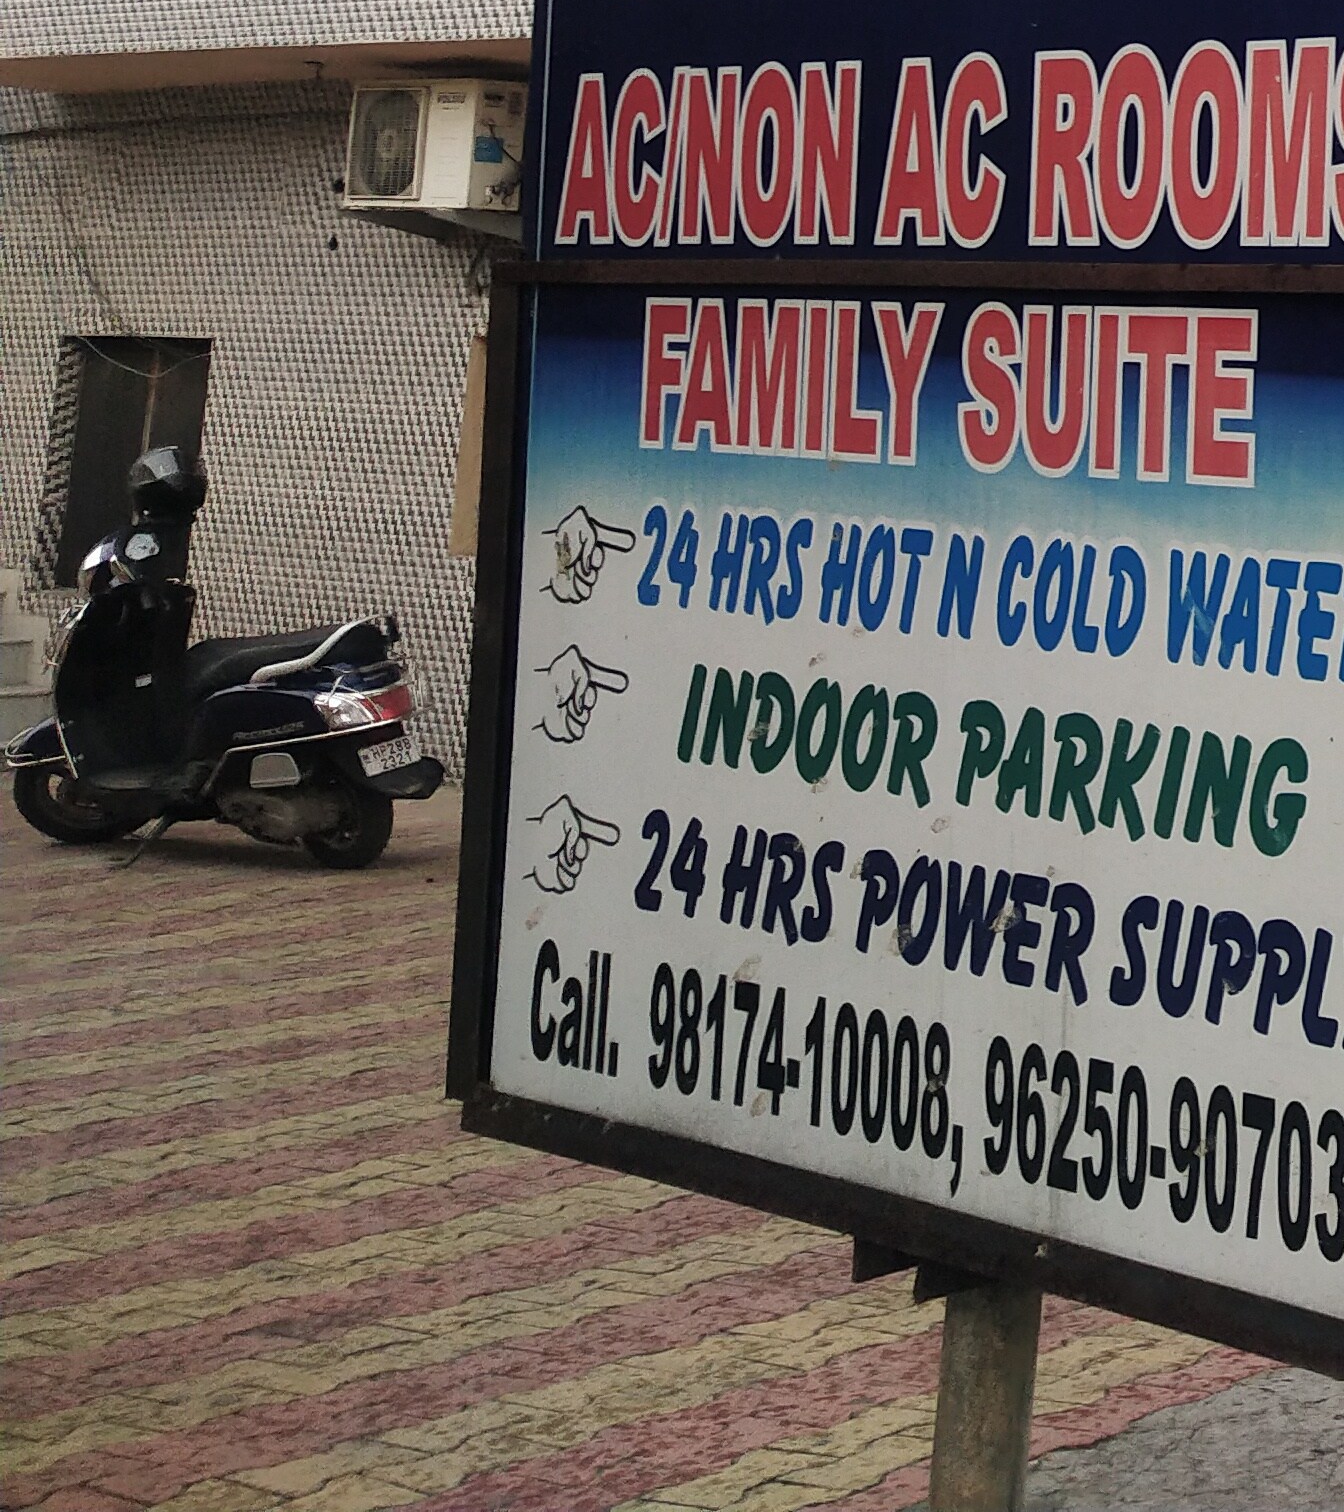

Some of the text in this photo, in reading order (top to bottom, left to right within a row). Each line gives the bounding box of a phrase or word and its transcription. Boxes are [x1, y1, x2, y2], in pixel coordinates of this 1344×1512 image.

[556, 61, 862, 247] AC/NON
[875, 53, 1007, 248] AC
[640, 297, 1259, 487] FAMILY SUITE
[637, 505, 699, 609] 24
[709, 512, 813, 625] HRS
[819, 522, 934, 634] HOT
[937, 533, 985, 640] N
[997, 535, 1147, 657] COLD
[677, 664, 1309, 856] INDOOR PARKING
[634, 808, 708, 918] 24
[721, 824, 845, 947] HRS
[856, 848, 1096, 1006] POWER
[530, 938, 619, 1078] Call.
[648, 962, 963, 1198] 98174-10008,
